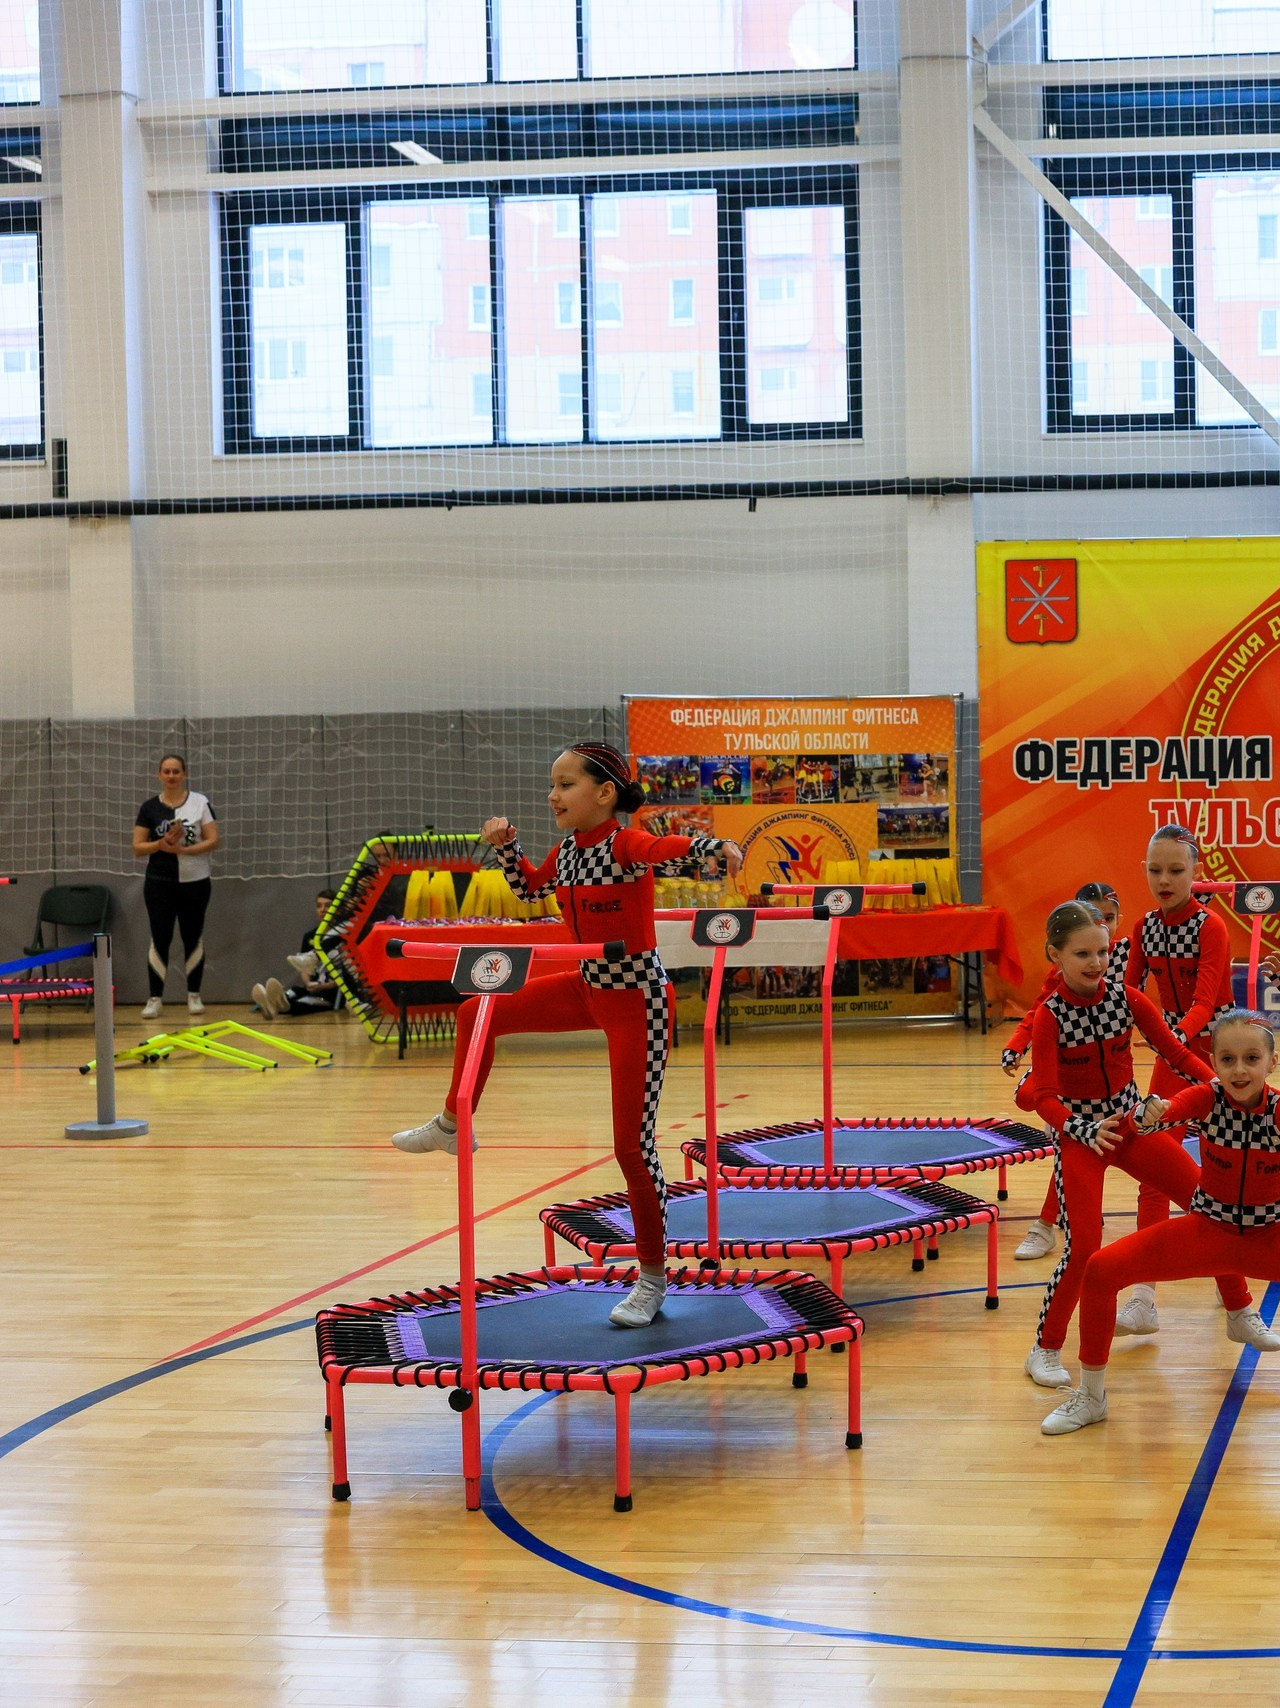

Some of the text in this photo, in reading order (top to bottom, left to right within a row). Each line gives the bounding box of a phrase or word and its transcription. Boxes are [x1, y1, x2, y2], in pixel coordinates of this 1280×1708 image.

[1193, 632, 1266, 738] ДЕРАЦИЯ
[670, 707, 919, 727] ФЕДЕРАЦИЯ ДЖАМПИНГ ФИТНЕСА
[724, 730, 869, 751] ТУЛЬСКОЙ ОБЛАСТИ
[1014, 735, 1271, 789] ФЕДЕРАЦИЯ
[763, 813, 809, 829] ДЖАМПИНГ
[811, 815, 843, 838] ФИТНЕСА
[842, 838, 856, 860] РОСС
